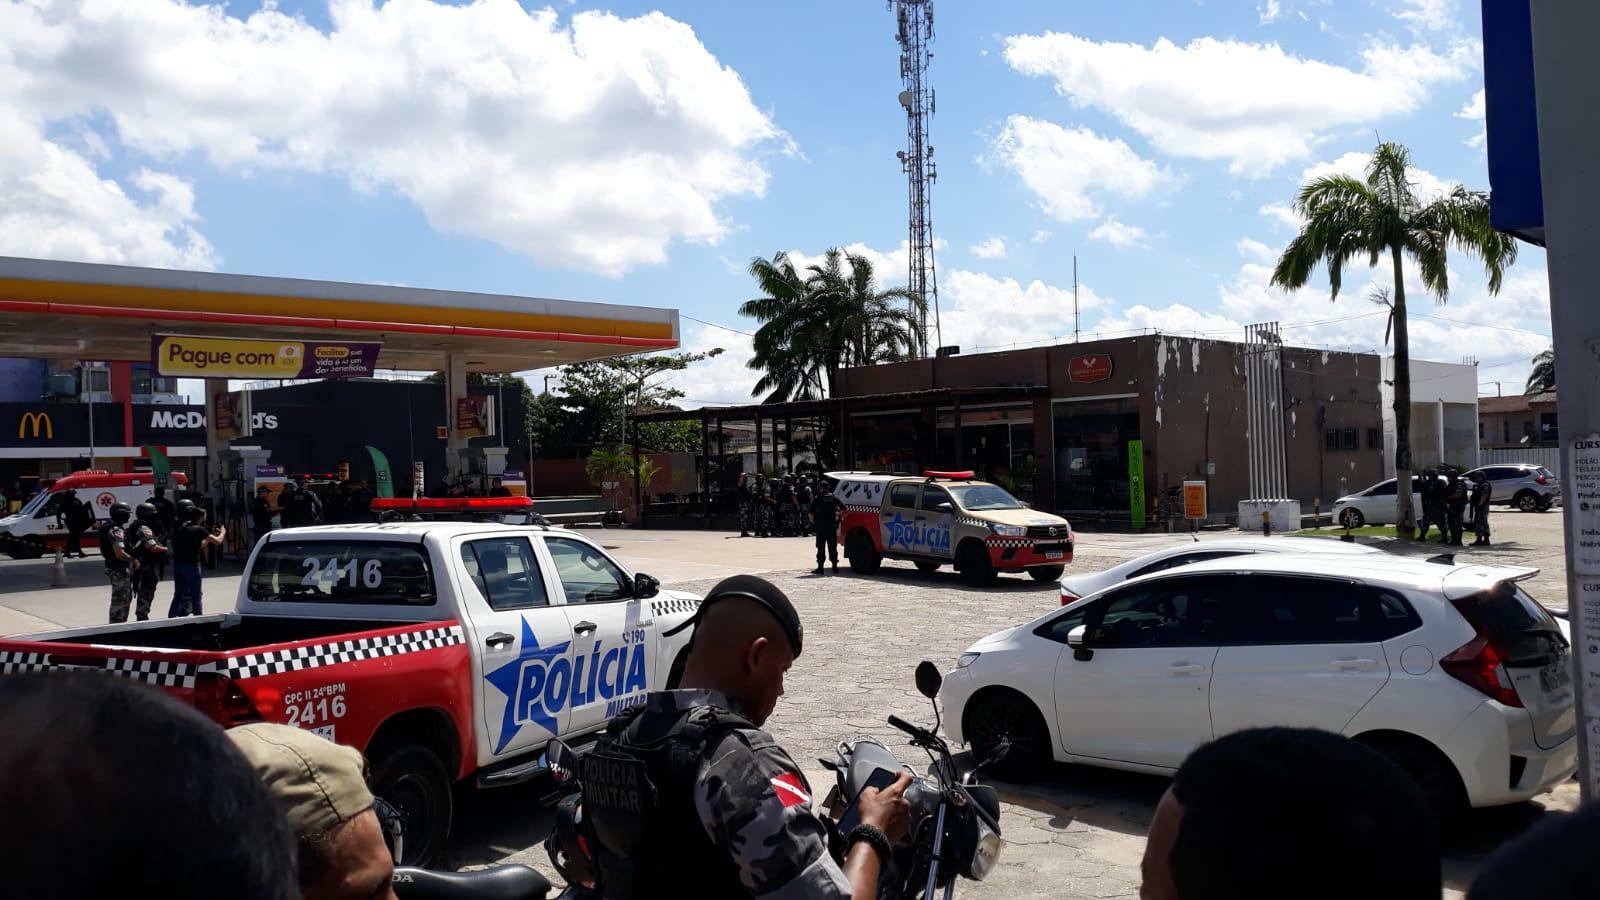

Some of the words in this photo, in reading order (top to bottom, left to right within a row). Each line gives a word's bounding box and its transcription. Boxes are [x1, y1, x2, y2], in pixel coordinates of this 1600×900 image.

[169, 343, 231, 368] Pague
[236, 352, 275, 365] com
[316, 358, 333, 366] vida
[150, 410, 279, 430] McDd's
[1574, 440, 1600, 450] CURS
[301, 556, 383, 589] 2416
[631, 629, 645, 643] 190
[518, 640, 646, 721] POLÍCIA
[285, 691, 303, 705] CPC
[305, 690, 312, 700] II
[285, 695, 347, 728] 2416
[585, 783, 641, 813] MILITAR
